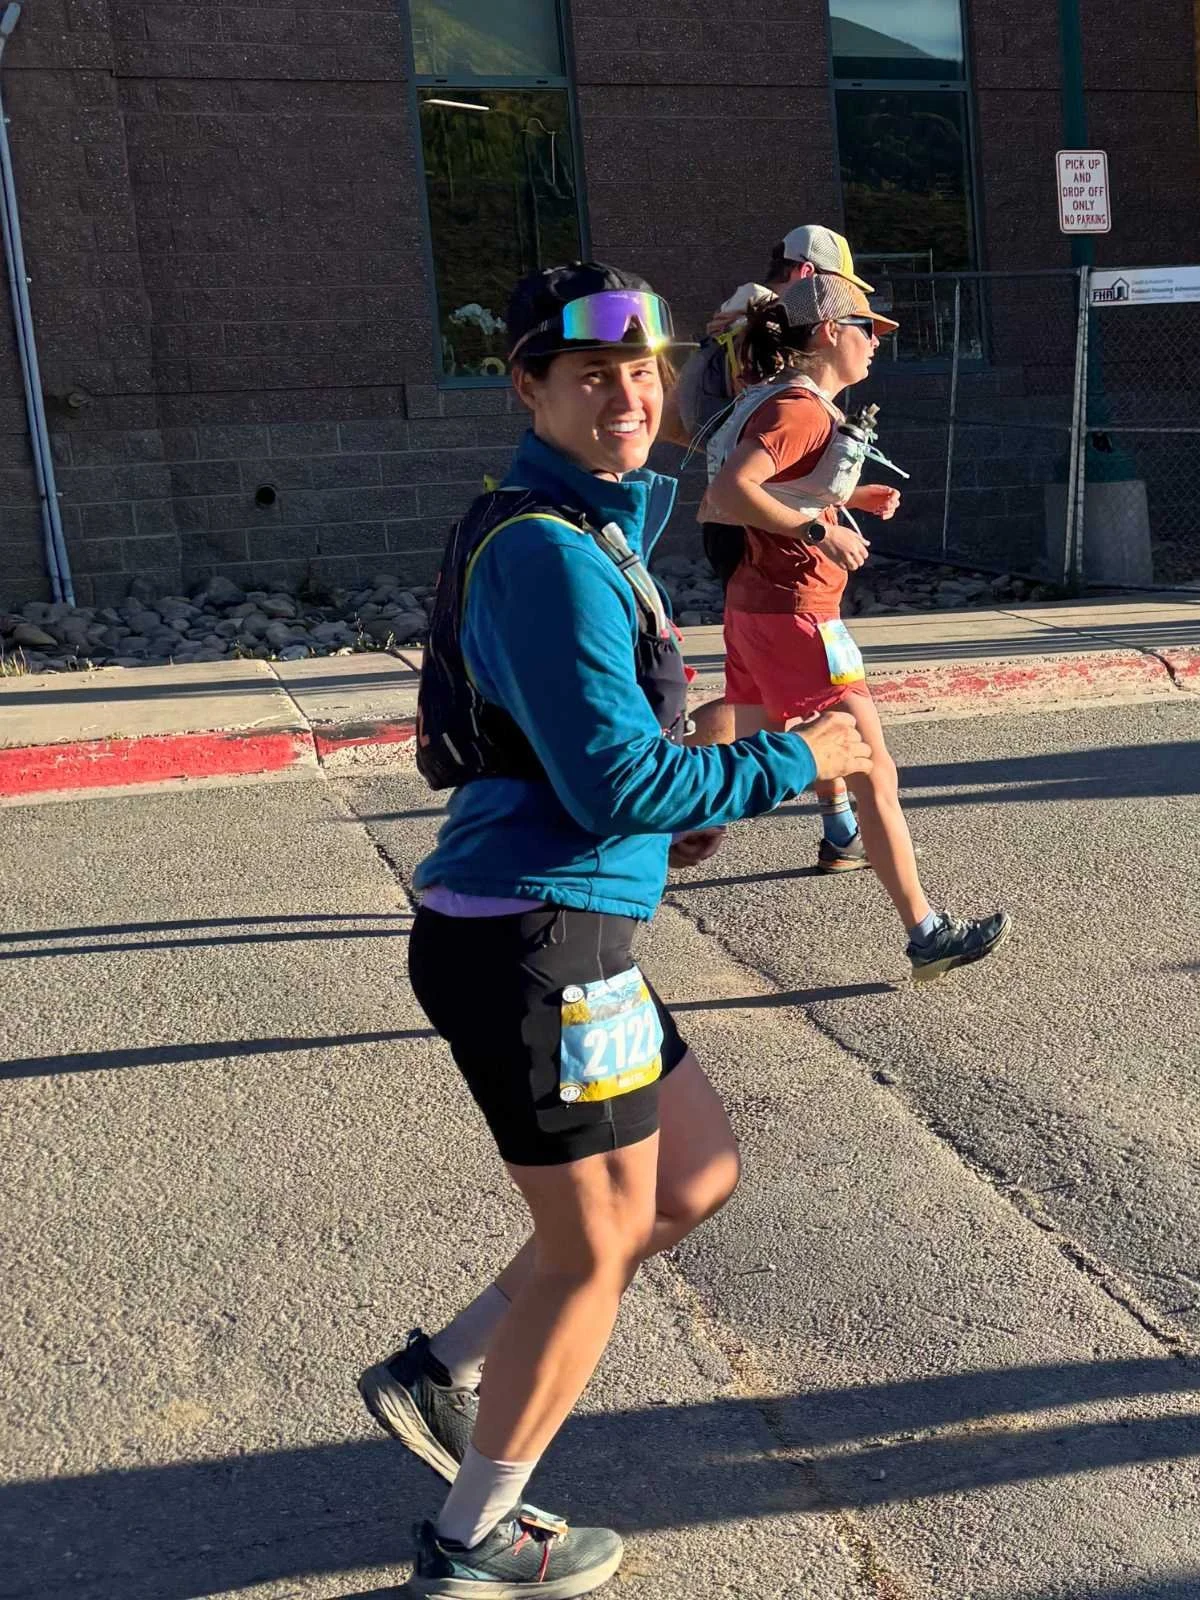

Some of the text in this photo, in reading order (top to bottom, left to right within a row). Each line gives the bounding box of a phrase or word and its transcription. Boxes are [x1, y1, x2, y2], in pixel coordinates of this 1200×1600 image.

[1065, 159, 1101, 169] PICK UP
[1073, 172, 1092, 183] AND
[1062, 186, 1105, 197] DROP OFF
[1072, 200, 1095, 211] ONLY
[1064, 214, 1106, 225] NO PARKING
